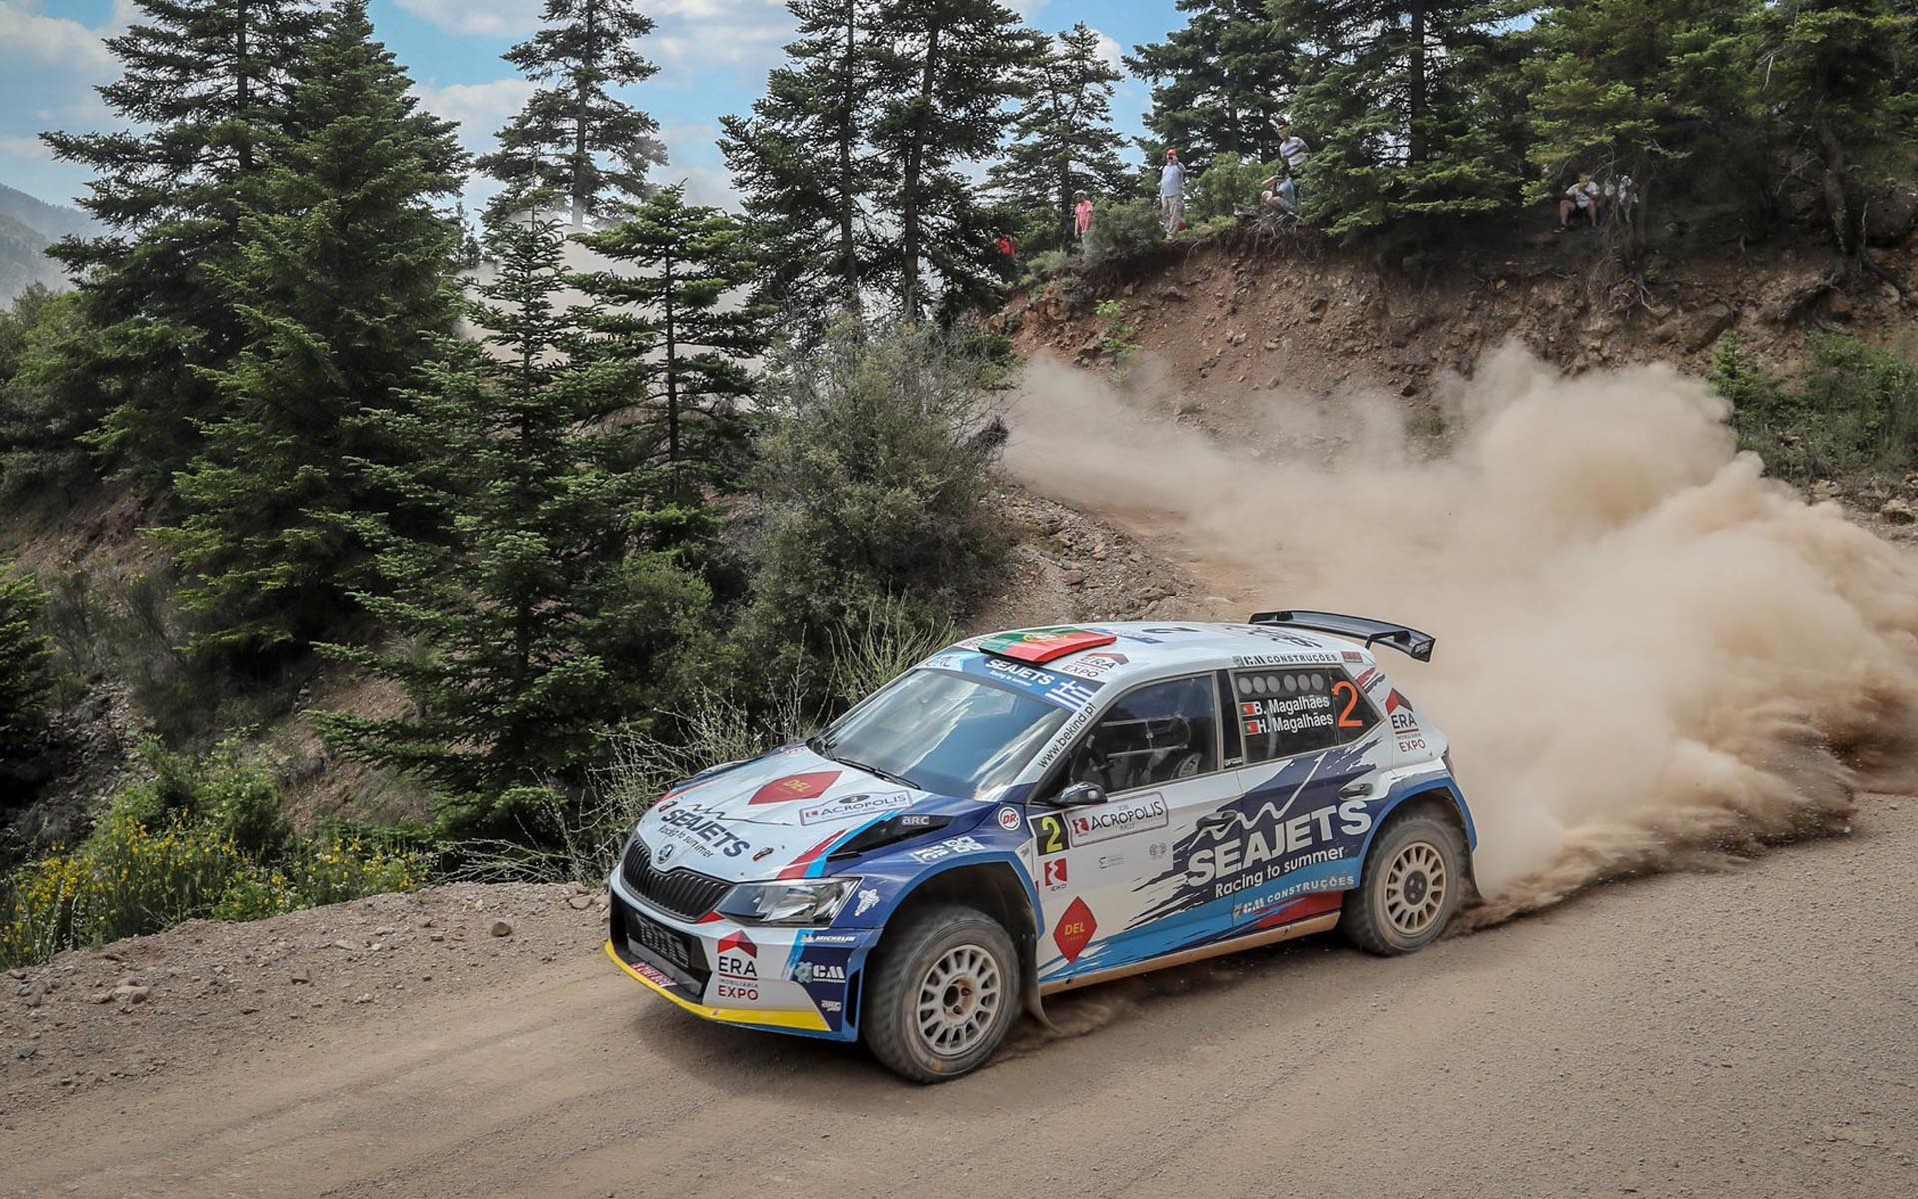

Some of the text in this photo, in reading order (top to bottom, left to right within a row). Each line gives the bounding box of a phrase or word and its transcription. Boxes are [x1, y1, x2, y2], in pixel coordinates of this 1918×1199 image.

[1081, 656, 1117, 669] ERA
[1267, 654, 1338, 665] CONSTRUÇÕES
[985, 659, 1056, 685] SEAJETS
[1062, 664, 1100, 678] EXPO
[1253, 694, 1330, 716] B. Magalhães
[1333, 681, 1364, 728] 2
[1258, 712, 1334, 734] H. Magalhães
[1391, 713, 1418, 729] ERA
[1038, 702, 1097, 769] www.bekind.pl
[1398, 739, 1426, 752] EXPO
[821, 794, 907, 816] ACROPOLIS
[1091, 801, 1164, 831] ACROPOLIS
[661, 809, 751, 857] SEAJETS
[1042, 816, 1063, 853] 2
[1188, 800, 1372, 887] SEAJETS
[1215, 846, 1345, 898] Racing to summer
[1267, 875, 1355, 904] CONSTRUÇÕES
[815, 935, 856, 943] MICHELIN
[1064, 922, 1086, 936] DEL
[719, 956, 757, 976] ERA
[813, 964, 845, 979] CM
[718, 985, 759, 1000] EXPO
